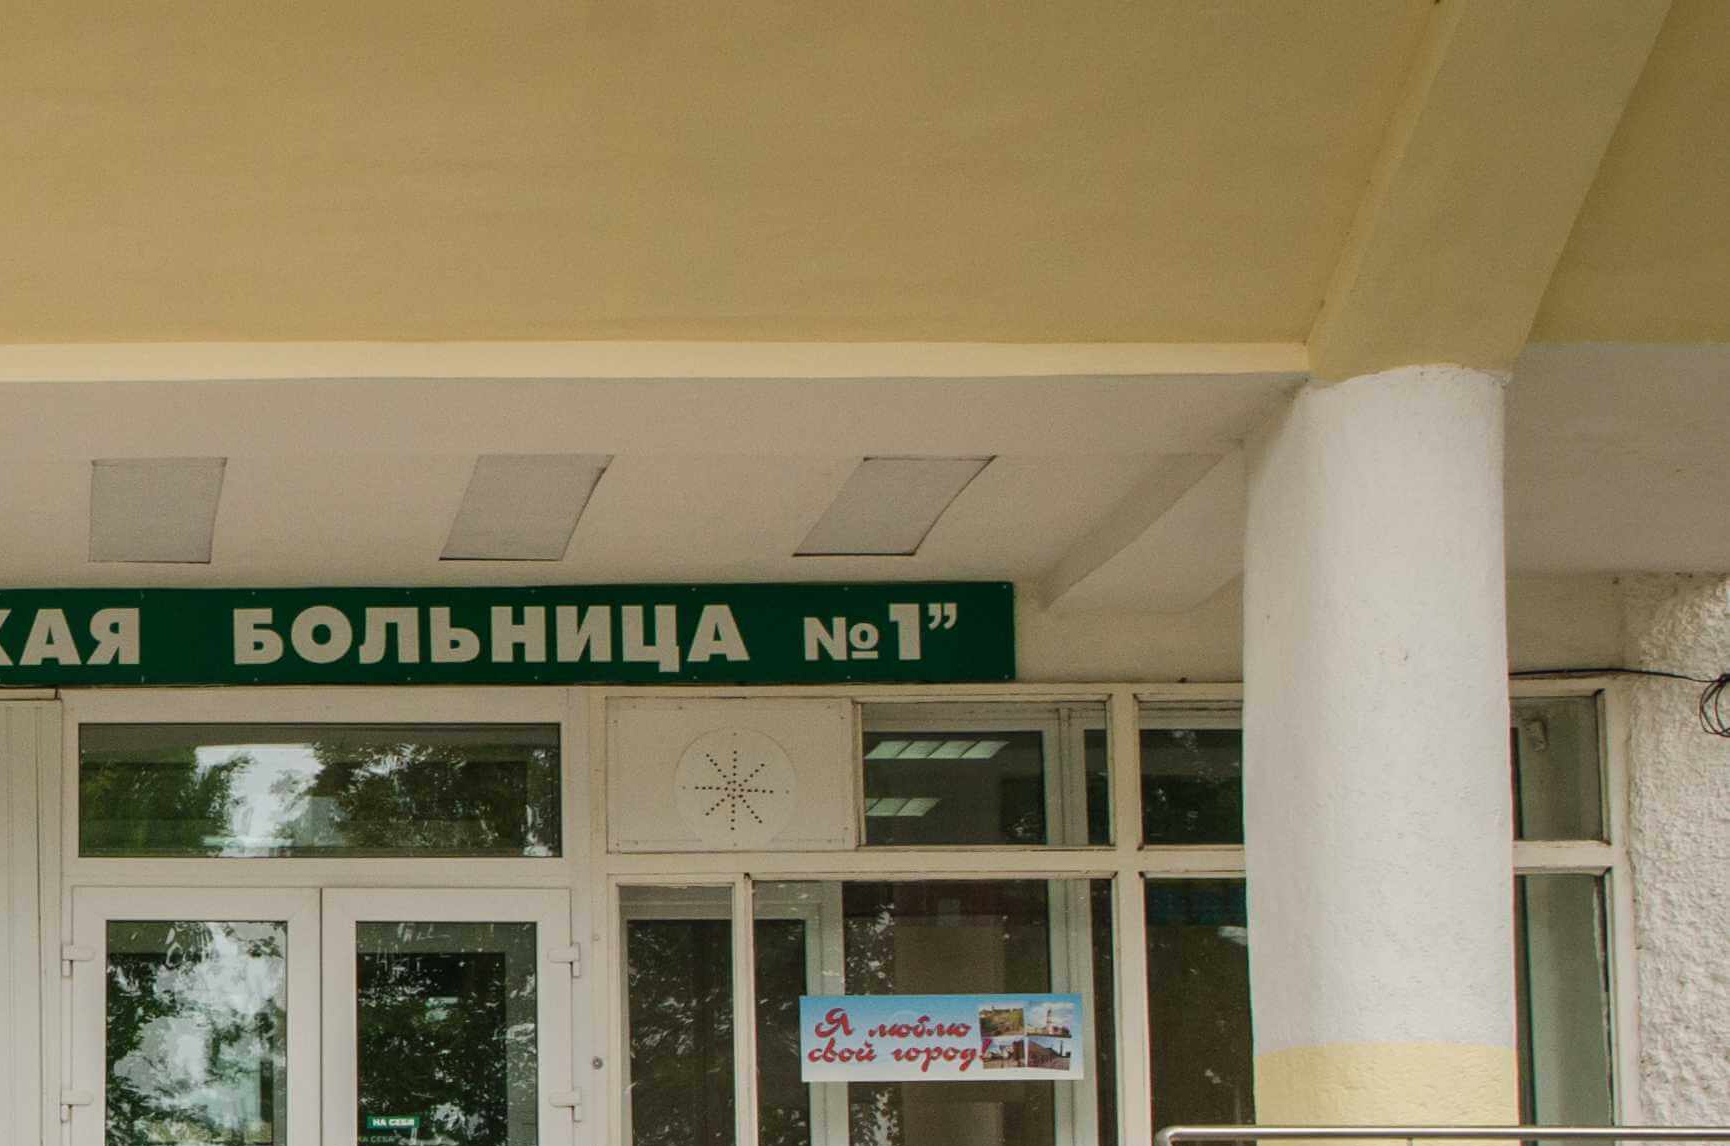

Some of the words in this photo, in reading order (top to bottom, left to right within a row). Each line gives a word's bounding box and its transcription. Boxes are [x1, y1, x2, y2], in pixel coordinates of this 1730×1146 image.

[233, 604, 750, 672] БОЛЬНИЦА
[814, 1007, 853, 1037] Я
[867, 1015, 973, 1038] люблю
[807, 1038, 878, 1063] свой
[890, 1039, 991, 1073] город!
